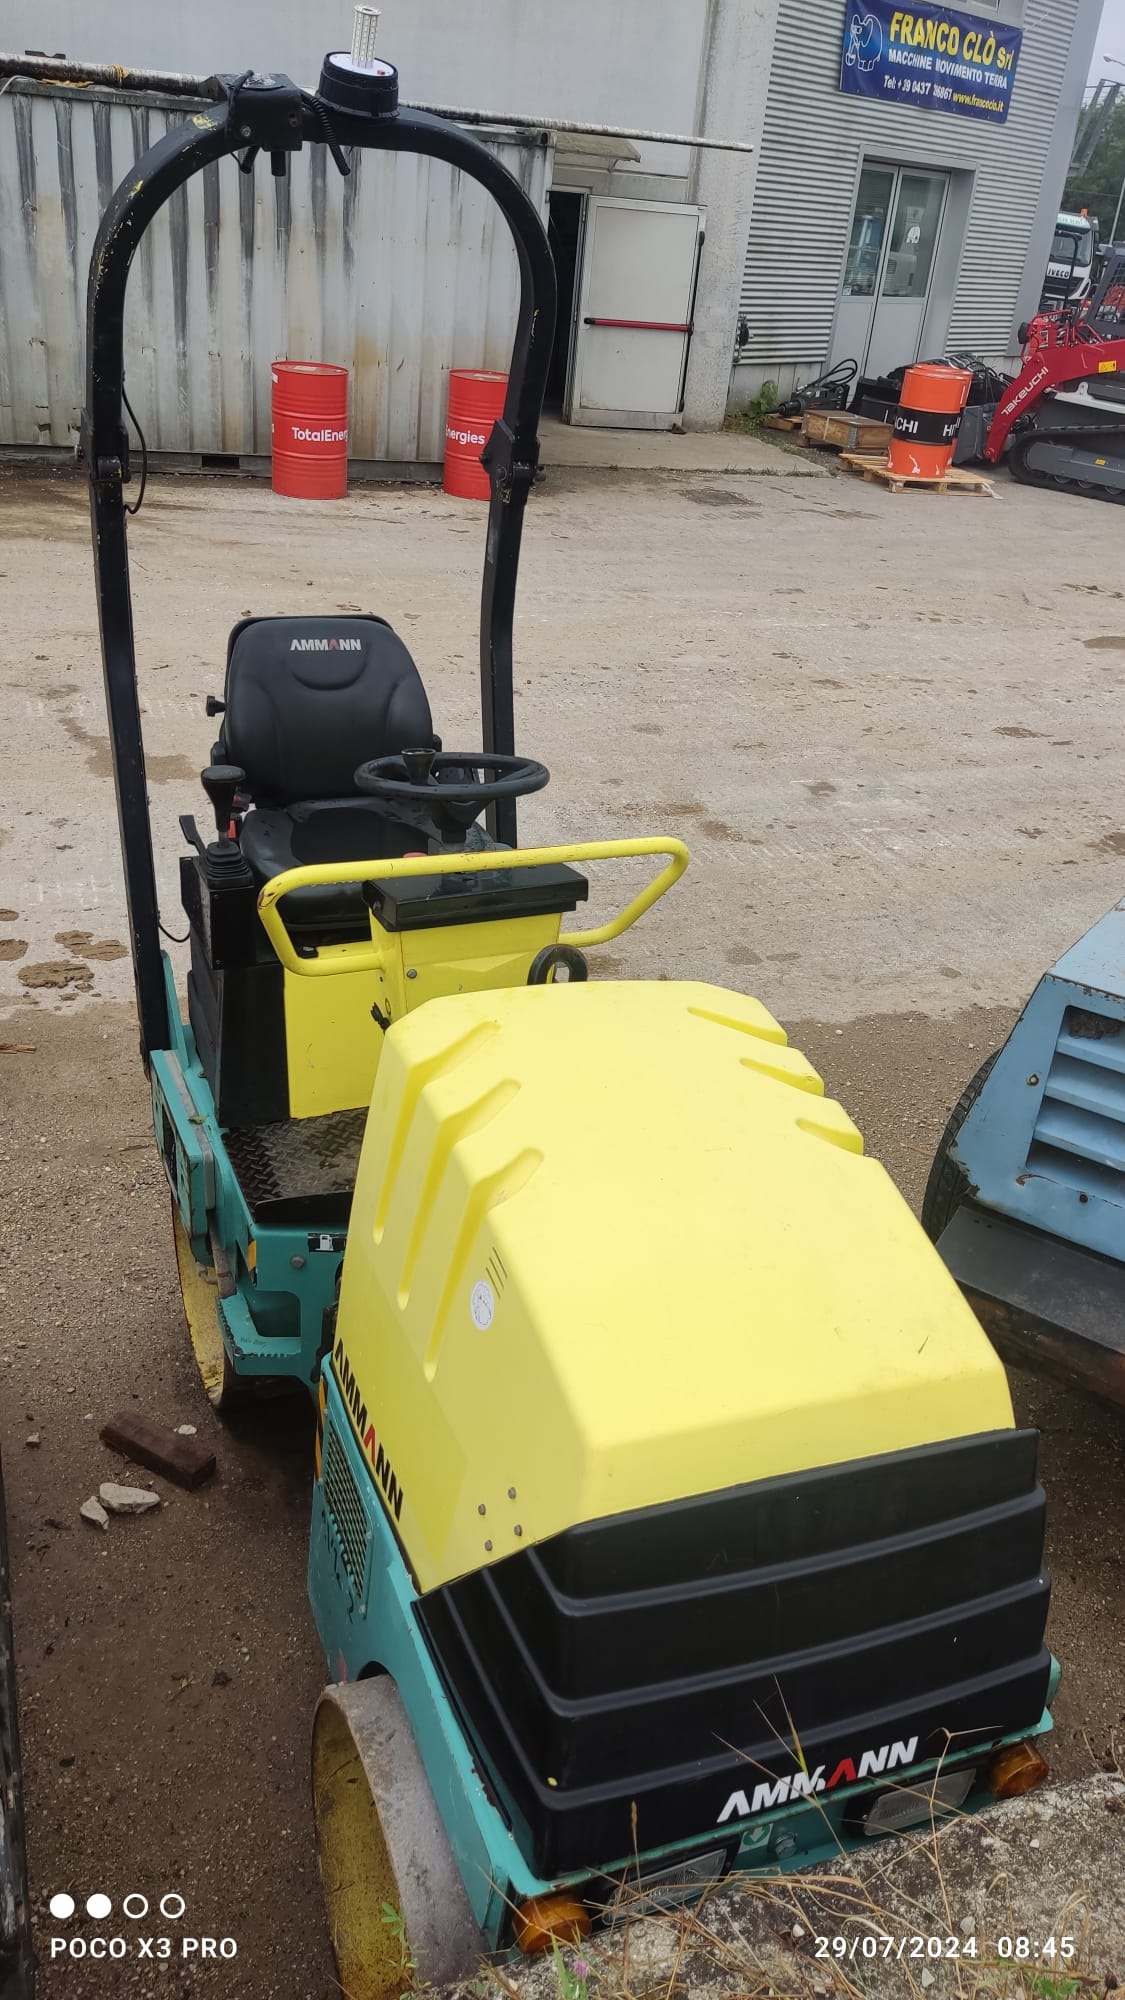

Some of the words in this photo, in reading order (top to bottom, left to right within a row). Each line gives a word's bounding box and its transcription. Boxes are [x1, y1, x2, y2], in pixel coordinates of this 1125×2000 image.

[890, 12, 960, 56] FRANCO
[963, 30, 997, 66] CLÒ
[997, 47, 1015, 71] Srl
[888, 49, 933, 71] MACCHINE
[935, 58, 983, 82] MOVIMENTO
[984, 71, 1008, 90] TERRA
[911, 80, 932, 95] 0437
[1047, 268, 1071, 278] IVECO
[894, 416, 919, 434] CHI
[290, 639, 362, 651] AMMANN
[333, 1337, 404, 1522] AMMANN
[716, 1736, 919, 1824] AMMANN
